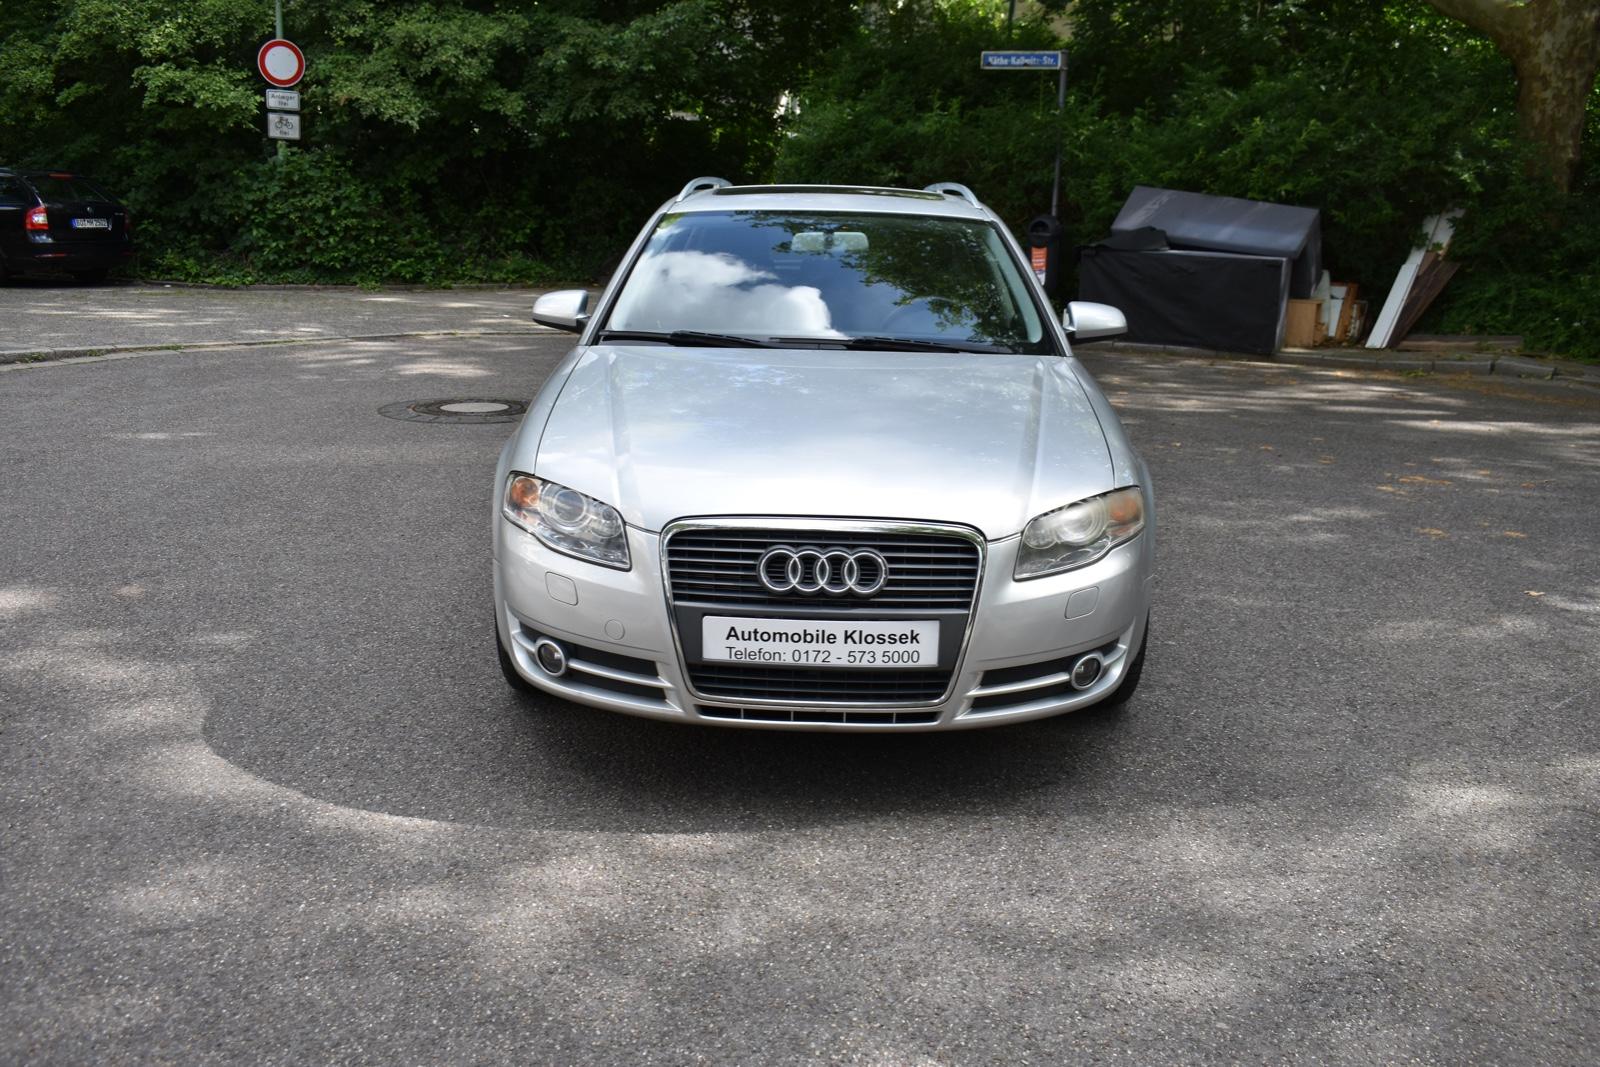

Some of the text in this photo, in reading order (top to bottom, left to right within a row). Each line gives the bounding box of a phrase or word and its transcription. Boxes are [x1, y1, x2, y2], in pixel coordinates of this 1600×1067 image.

[725, 626, 920, 645] Automobile Klossek
[725, 646, 786, 662] Telefon:
[792, 649, 831, 663] 0172
[847, 650, 876, 664] 573
[881, 650, 920, 664] 5000
